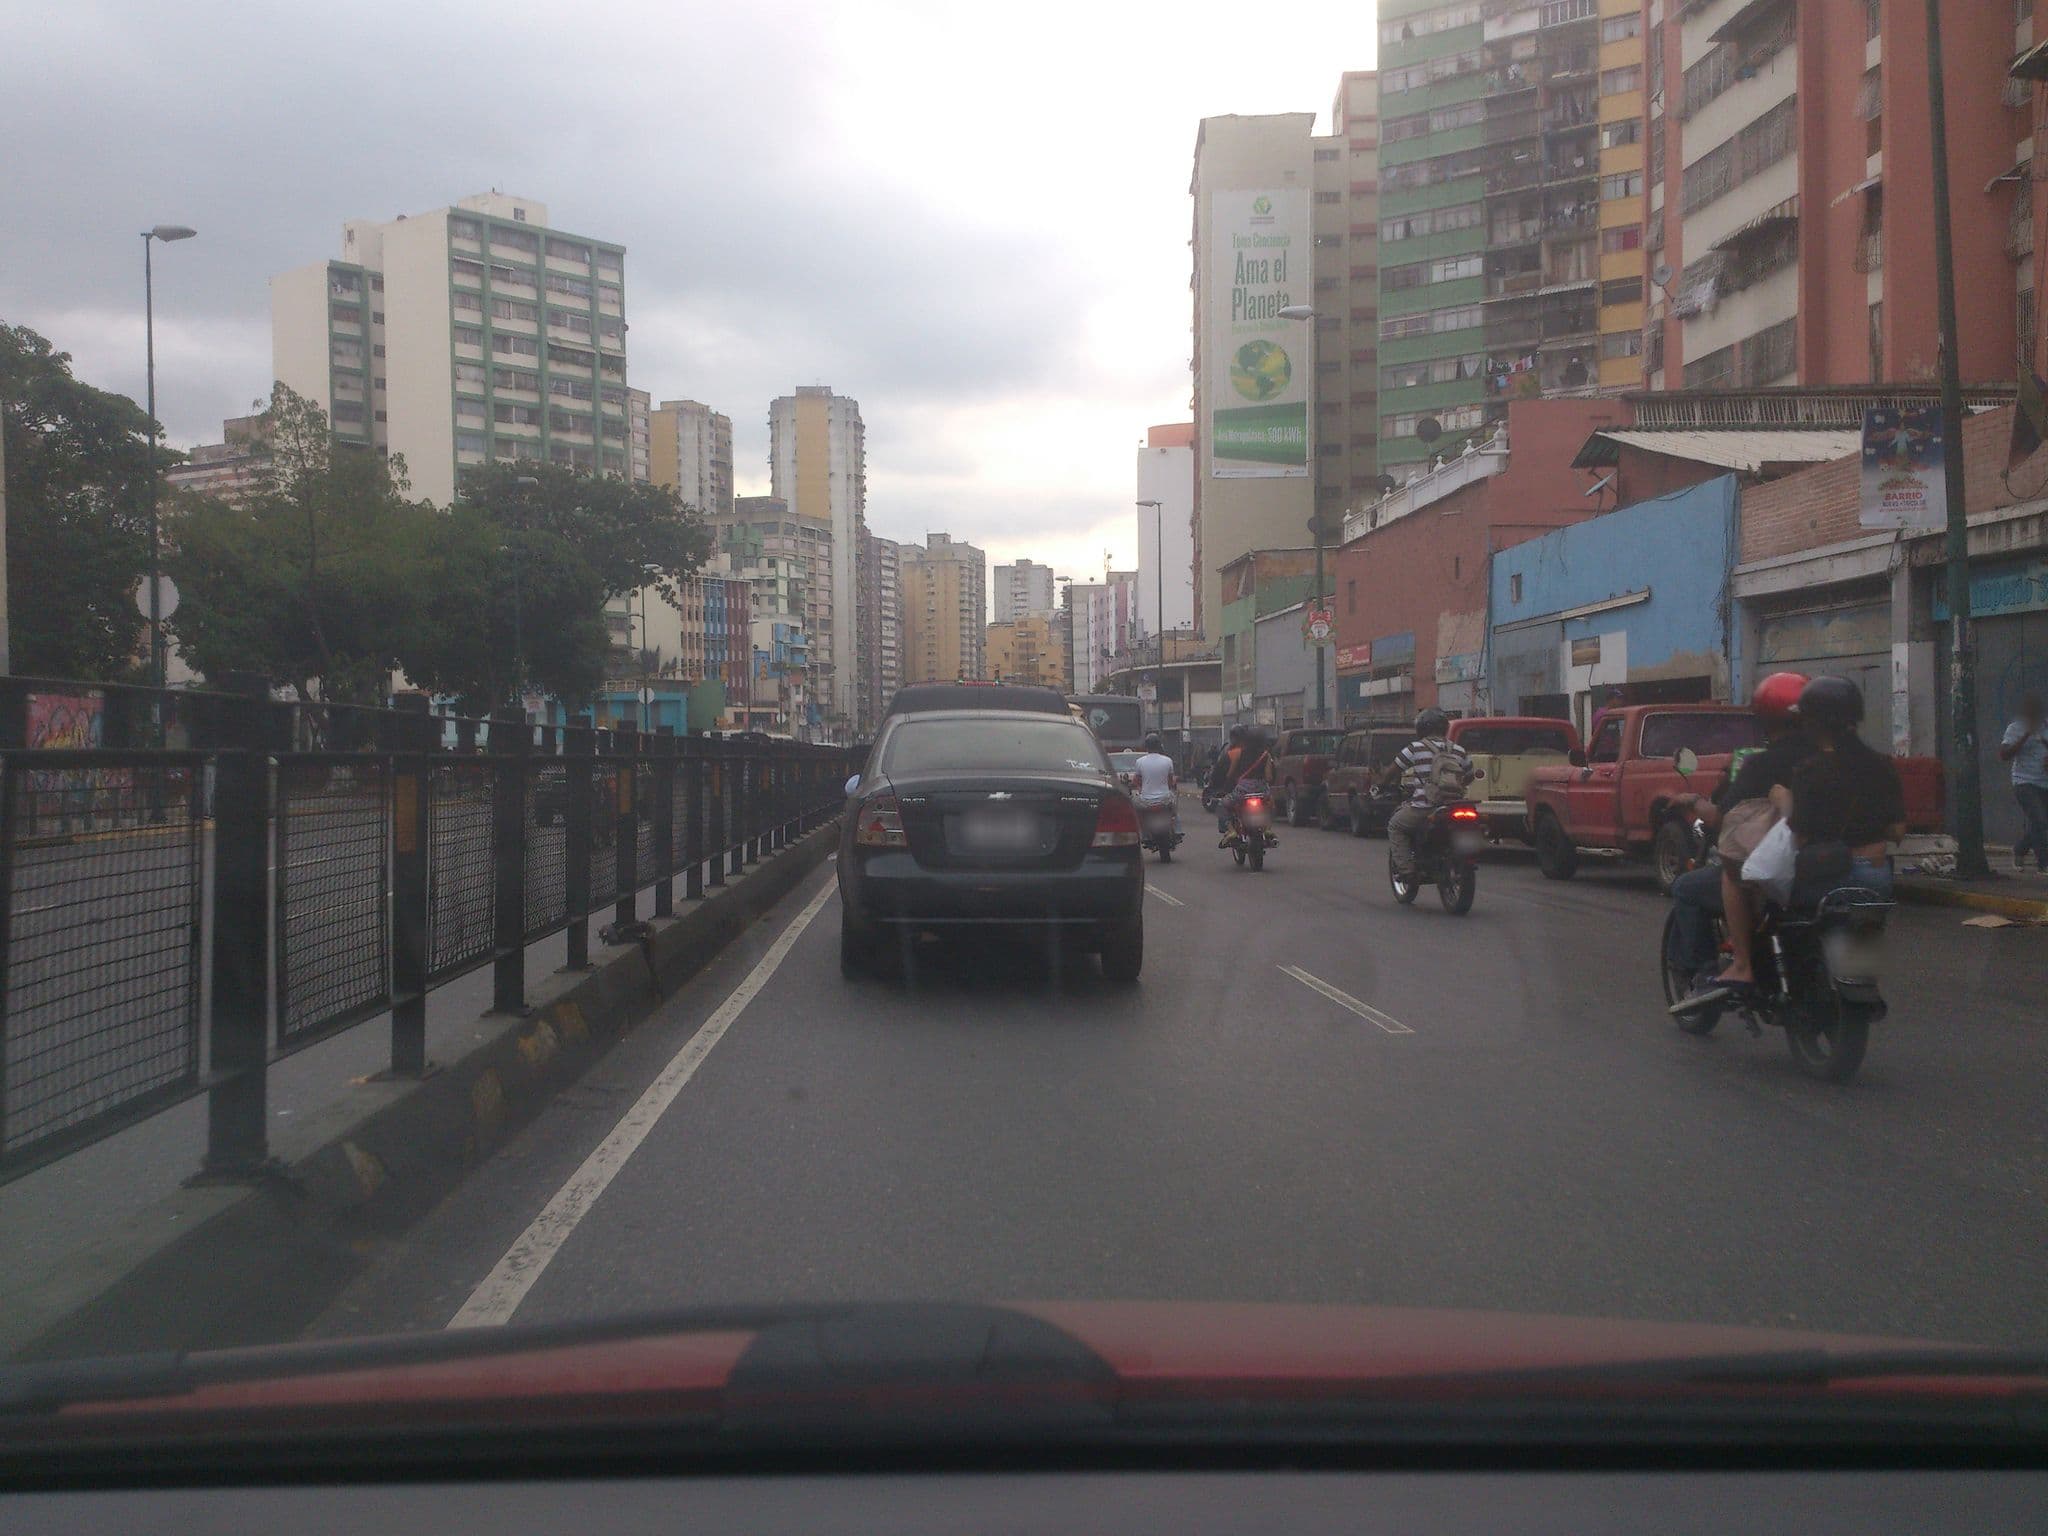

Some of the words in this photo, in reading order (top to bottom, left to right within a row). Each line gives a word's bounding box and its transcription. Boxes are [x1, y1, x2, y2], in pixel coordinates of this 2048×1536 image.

[1234, 250, 1269, 285] Ama
[1274, 249, 1287, 282] el
[1231, 286, 1291, 321] Planeta
[1884, 492, 1923, 501] BARRIO
